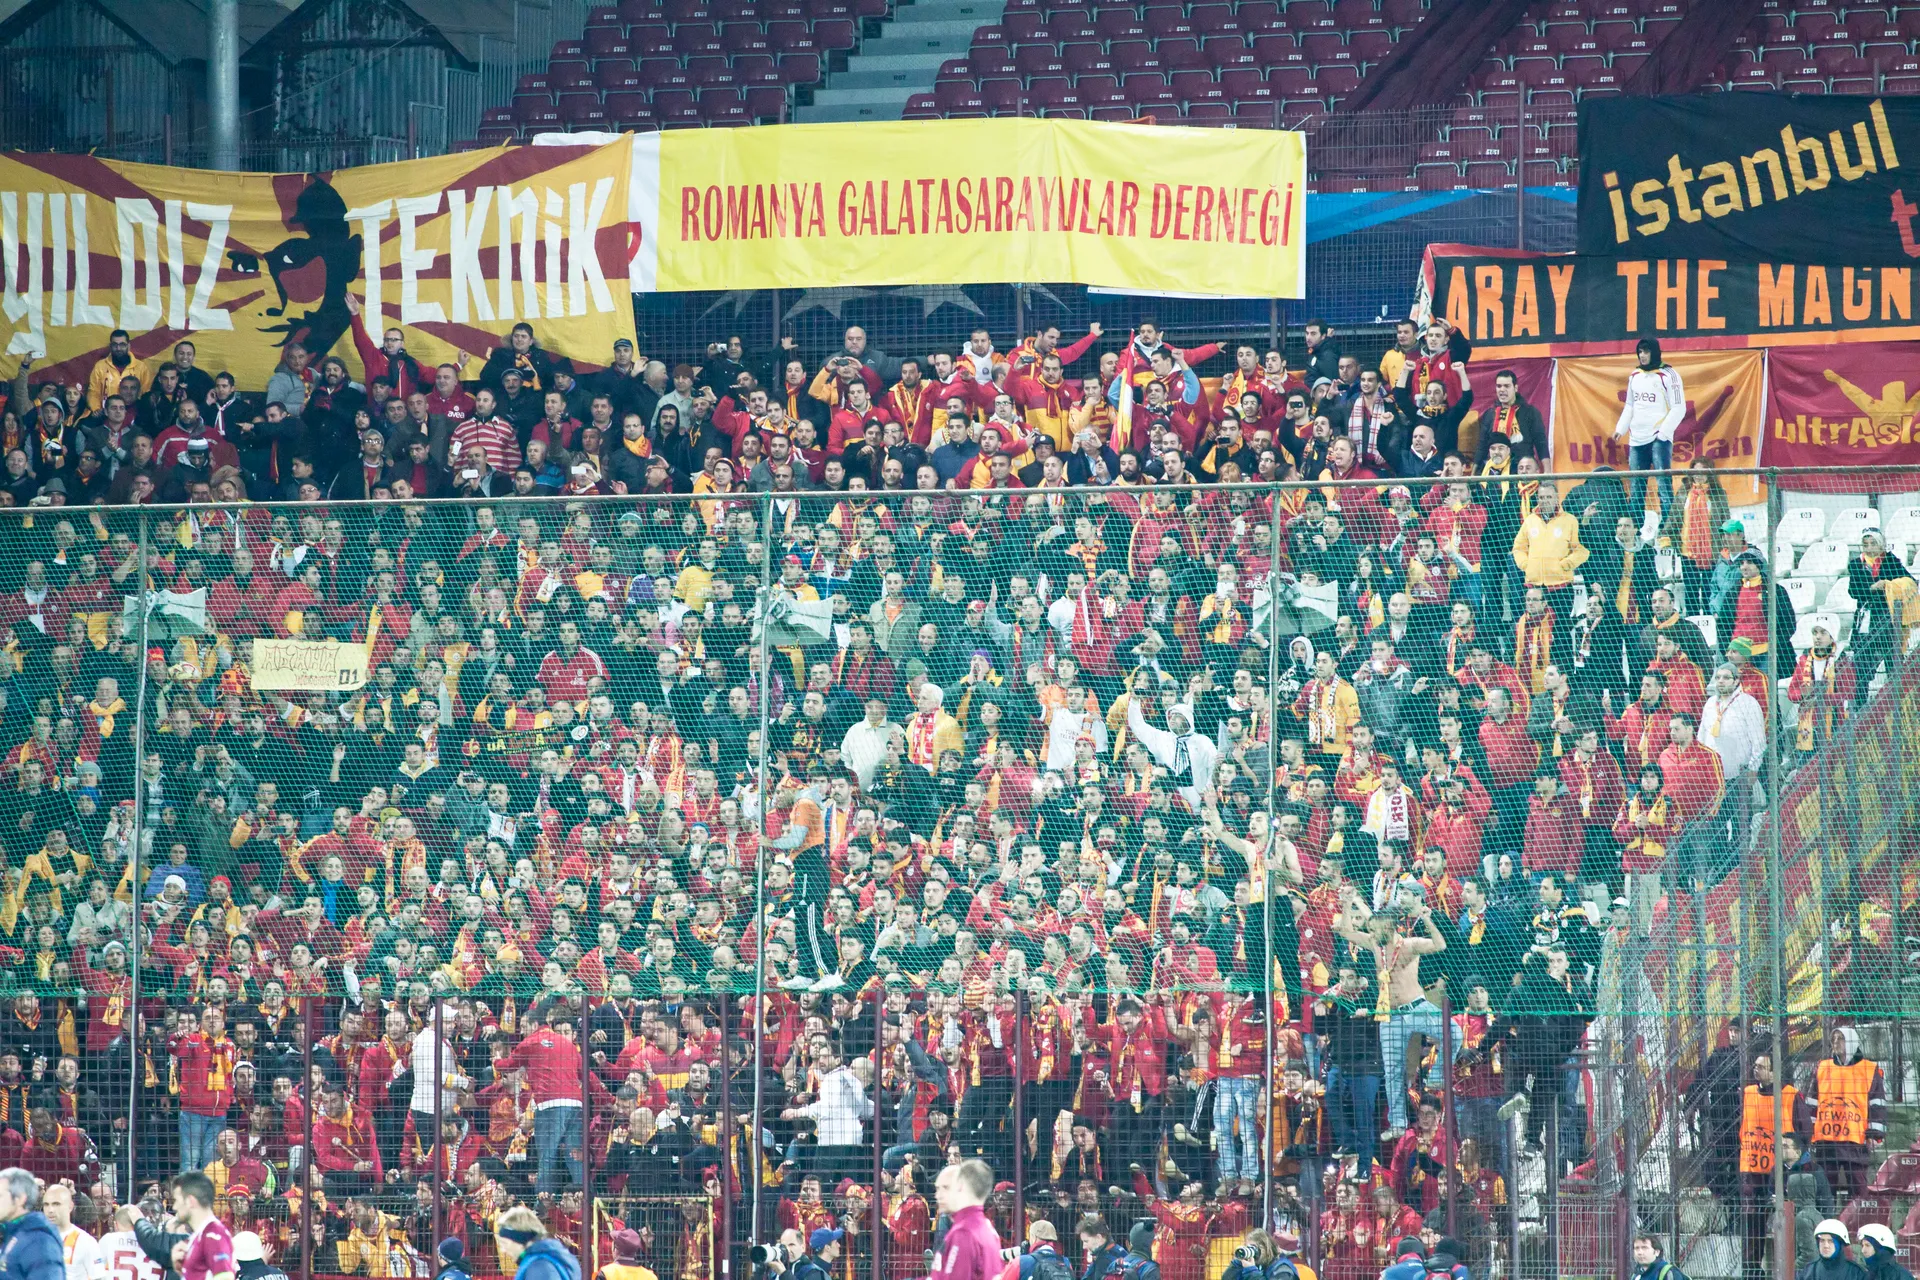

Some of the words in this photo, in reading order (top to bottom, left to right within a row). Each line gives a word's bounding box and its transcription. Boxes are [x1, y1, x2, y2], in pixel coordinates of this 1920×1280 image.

[1602, 97, 1900, 245] istanbul
[681, 181, 826, 242] ROMANYA
[1616, 258, 1727, 332] THE
[447, 409, 465, 419] avea
[1818, 1110, 1861, 1123] TEWARD
[1821, 1122, 1850, 1137] 096
